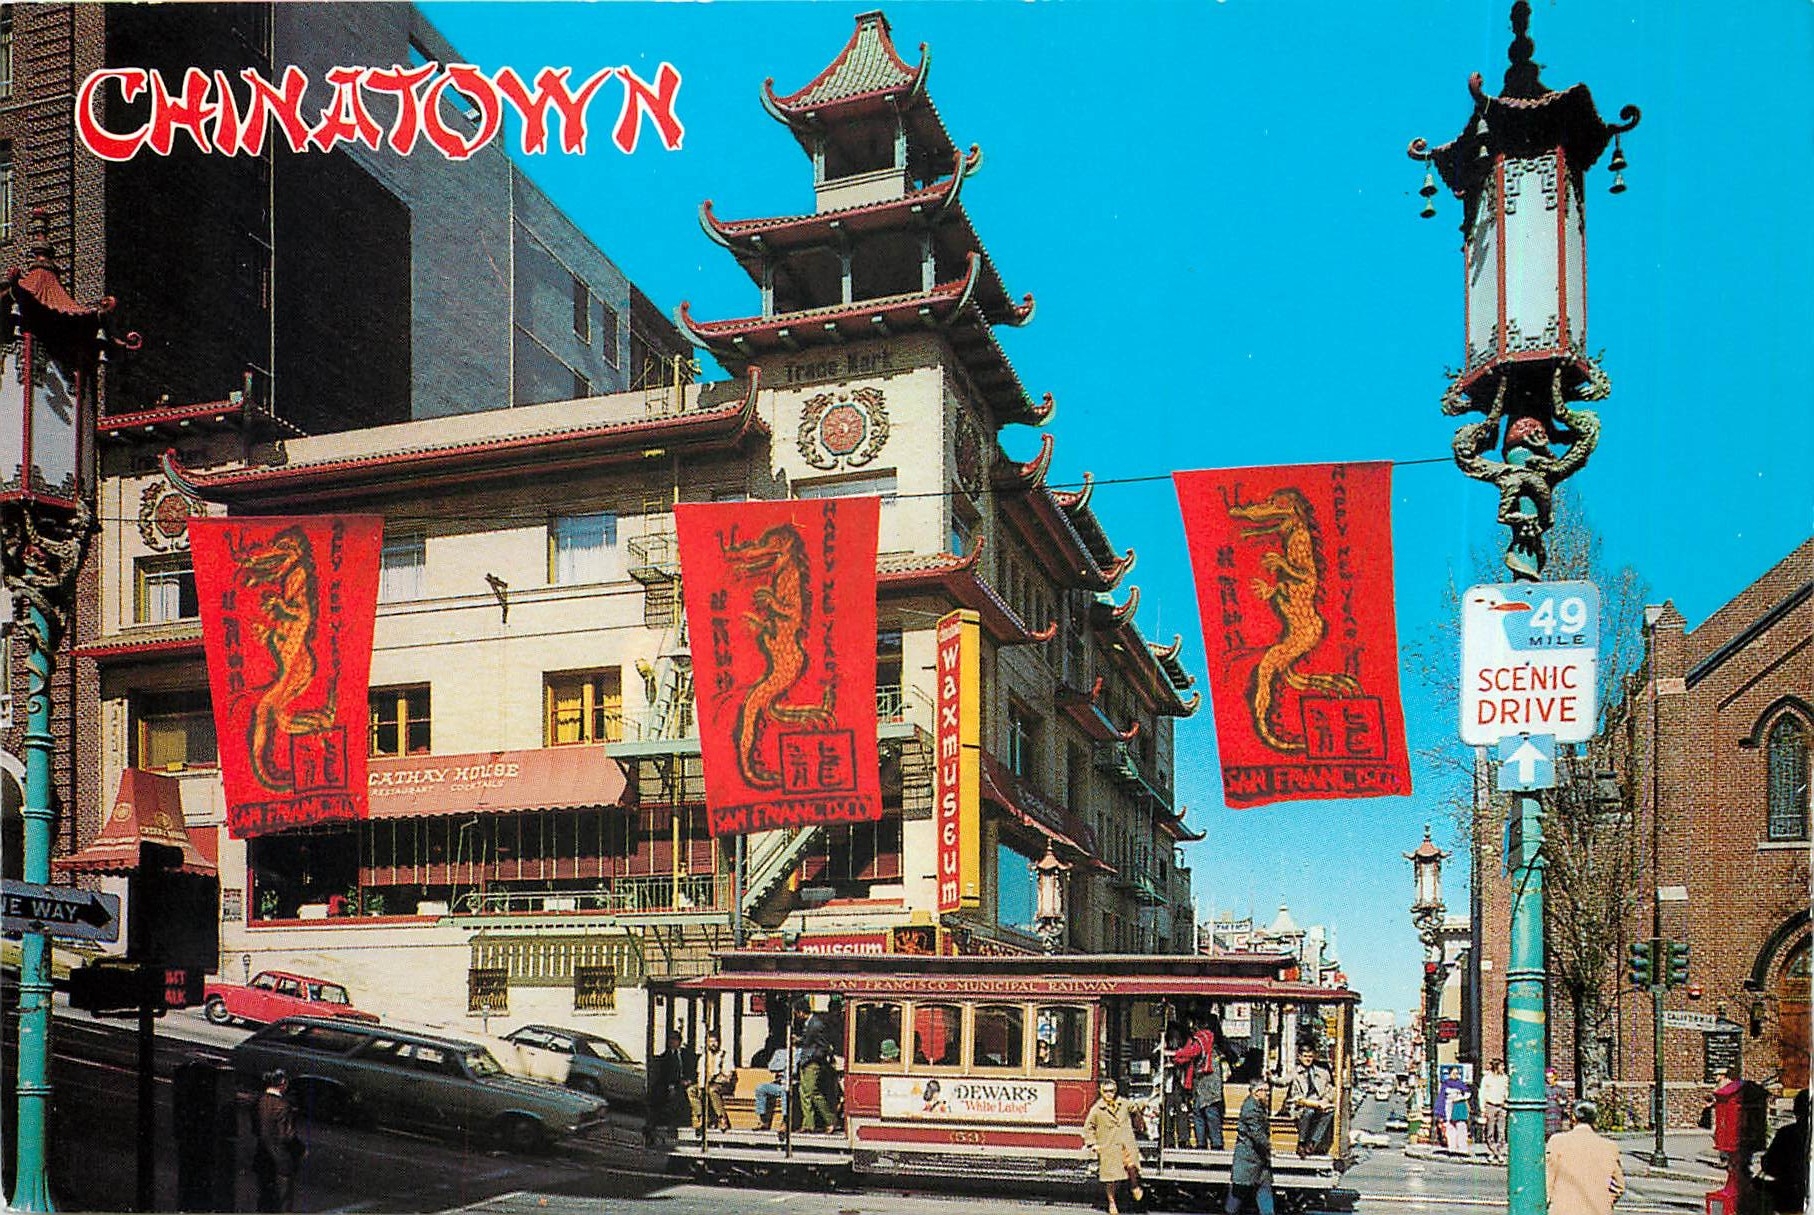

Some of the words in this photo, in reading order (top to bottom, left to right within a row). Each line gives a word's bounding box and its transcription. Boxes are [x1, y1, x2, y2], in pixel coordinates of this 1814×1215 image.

[1530, 597, 1588, 635] 49
[1529, 634, 1586, 646] MILE
[1478, 665, 1577, 692] SCENIC
[1477, 696, 1577, 725] DRIVE
[369, 768, 449, 786] CATHAY
[455, 763, 519, 781] HOUSE
[1228, 769, 1267, 793] SAN
[31, 900, 79, 922] WAY
[828, 979, 857, 991] SAN
[865, 979, 948, 992] FRANCISCO
[956, 980, 1038, 992] MUNICIPAL
[1048, 981, 1118, 992] RAILWAY
[956, 1084, 1038, 1101] DEWAR'S
